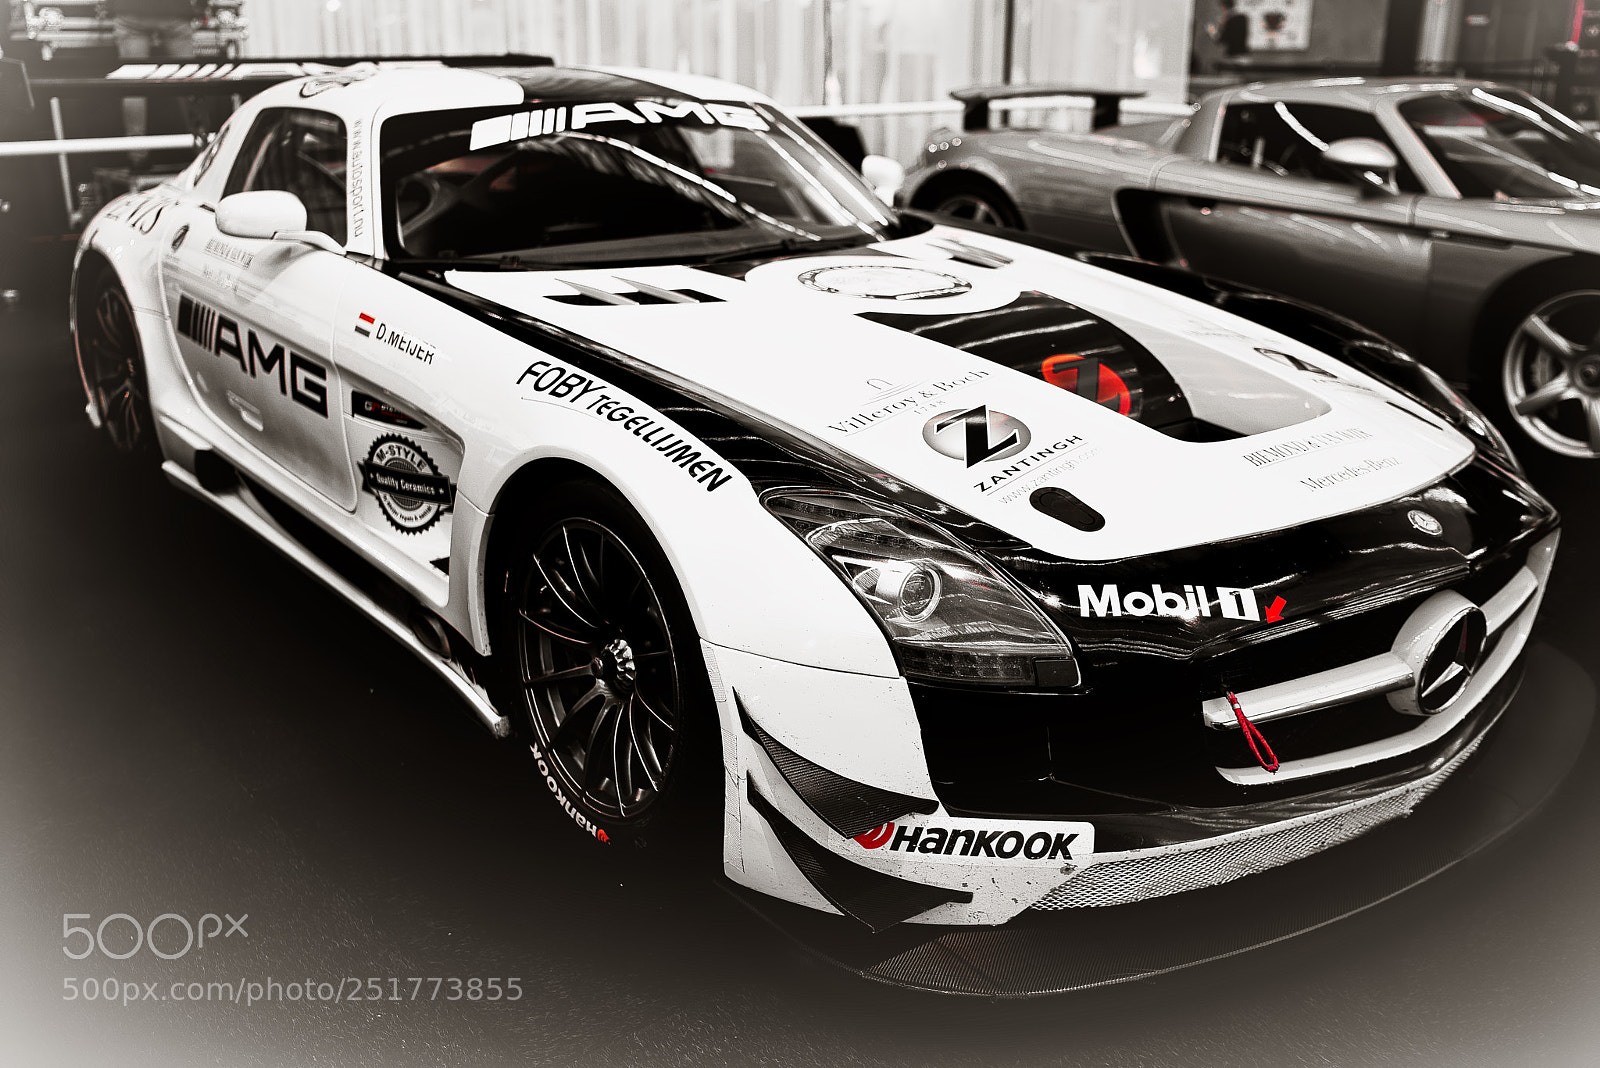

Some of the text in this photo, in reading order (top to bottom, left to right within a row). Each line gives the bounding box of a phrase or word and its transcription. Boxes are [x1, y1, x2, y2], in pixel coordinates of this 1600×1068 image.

[571, 101, 770, 131] AMG
[214, 314, 329, 418] AMG
[376, 322, 435, 365] D.MEIJER
[516, 360, 732, 492] FOBY TEGELLIJMEN
[827, 396, 919, 433] Villeroy
[932, 371, 989, 391] Boch
[935, 404, 1020, 468] Z
[1243, 440, 1310, 467] BIEMOND
[376, 472, 435, 495] Quality Ceramics
[973, 435, 1083, 492] ZANTINGH
[1077, 583, 1212, 618] Mobil
